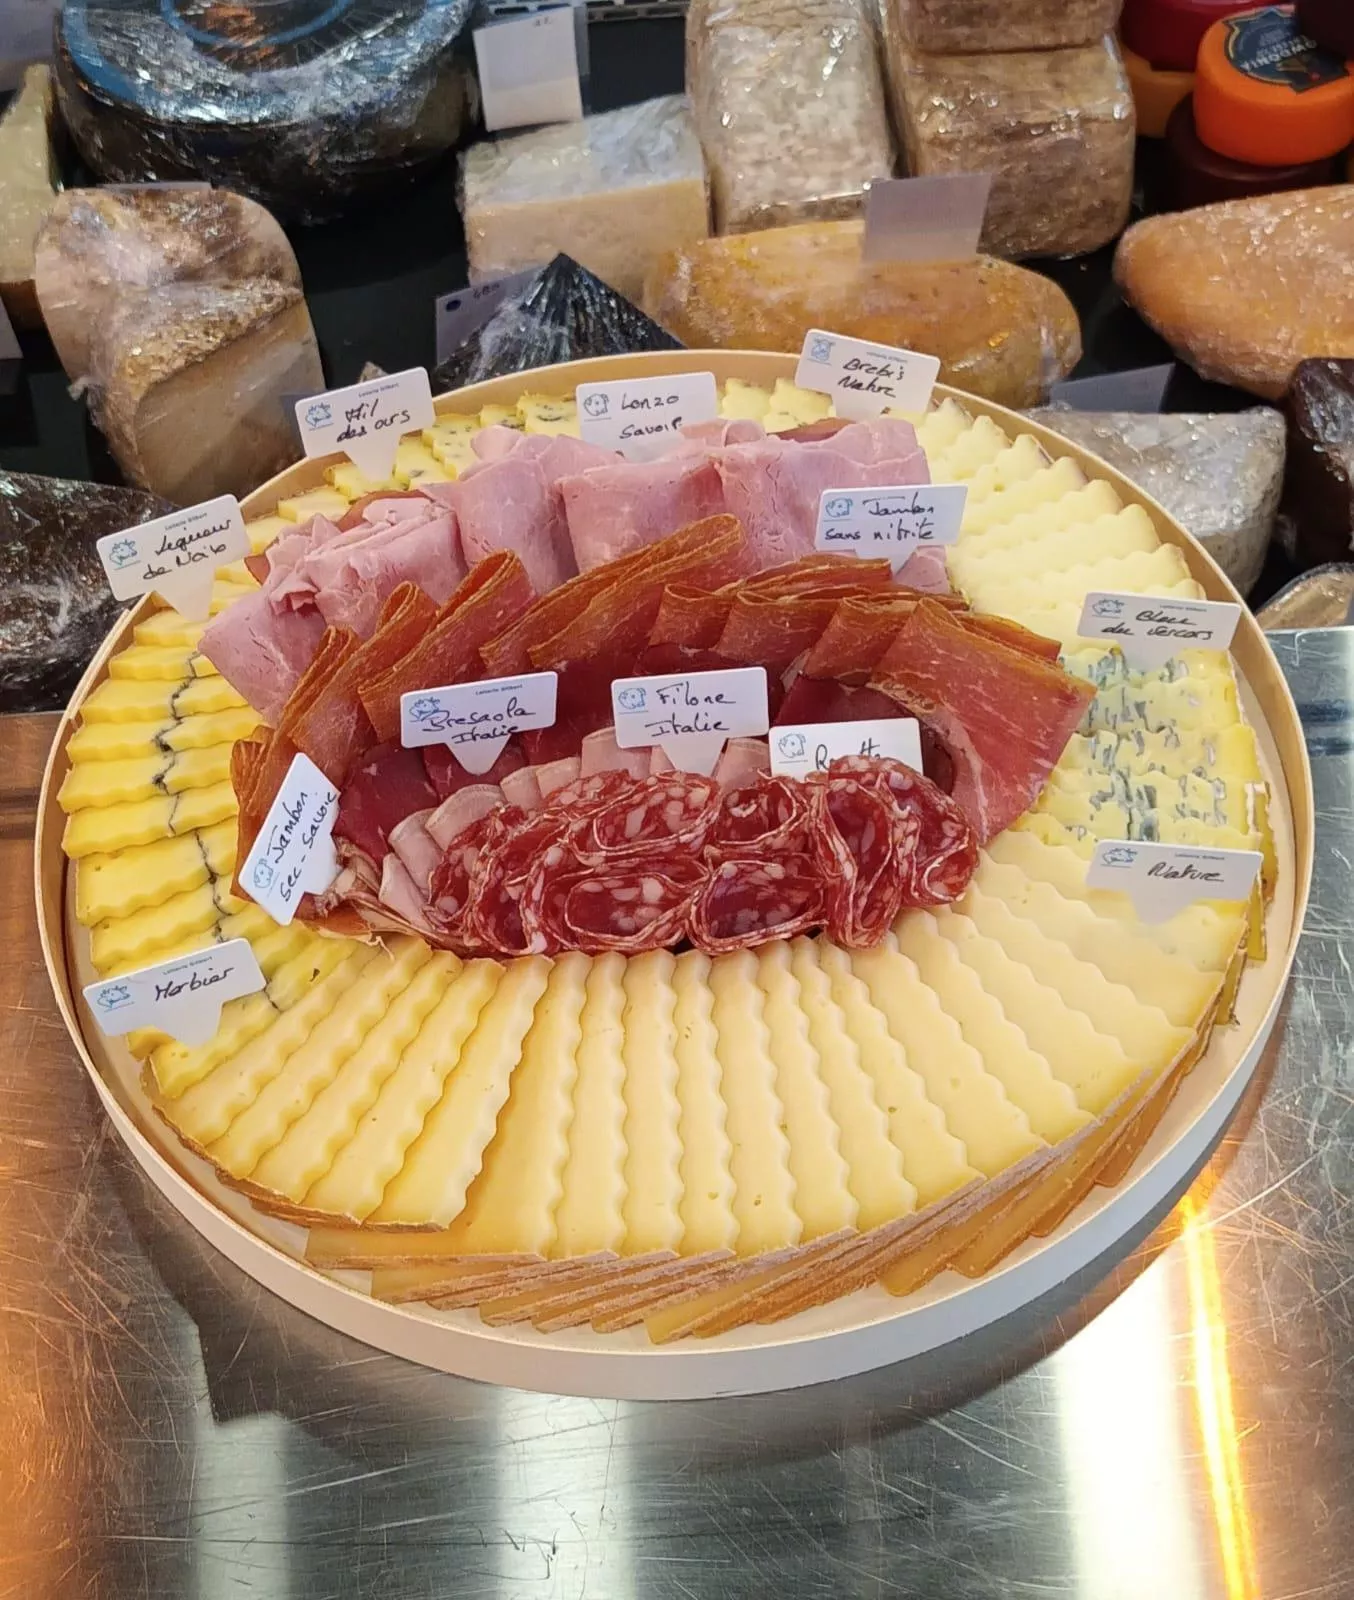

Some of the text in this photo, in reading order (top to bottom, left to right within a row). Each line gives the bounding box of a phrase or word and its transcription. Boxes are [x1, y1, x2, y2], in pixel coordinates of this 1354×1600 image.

[621, 392, 679, 410] Lonzo
[375, 410, 411, 431] ours
[862, 491, 935, 516] Jambon
[873, 517, 935, 541] nitrite
[142, 564, 173, 580] de
[1101, 621, 1135, 636] du
[656, 680, 737, 706] Filone
[422, 696, 537, 733] Bresaola
[644, 711, 730, 738] Italie
[451, 724, 520, 745] Italie
[266, 791, 308, 865] Jambon
[1147, 861, 1225, 883] Nature
[154, 966, 235, 1002] Morbier
